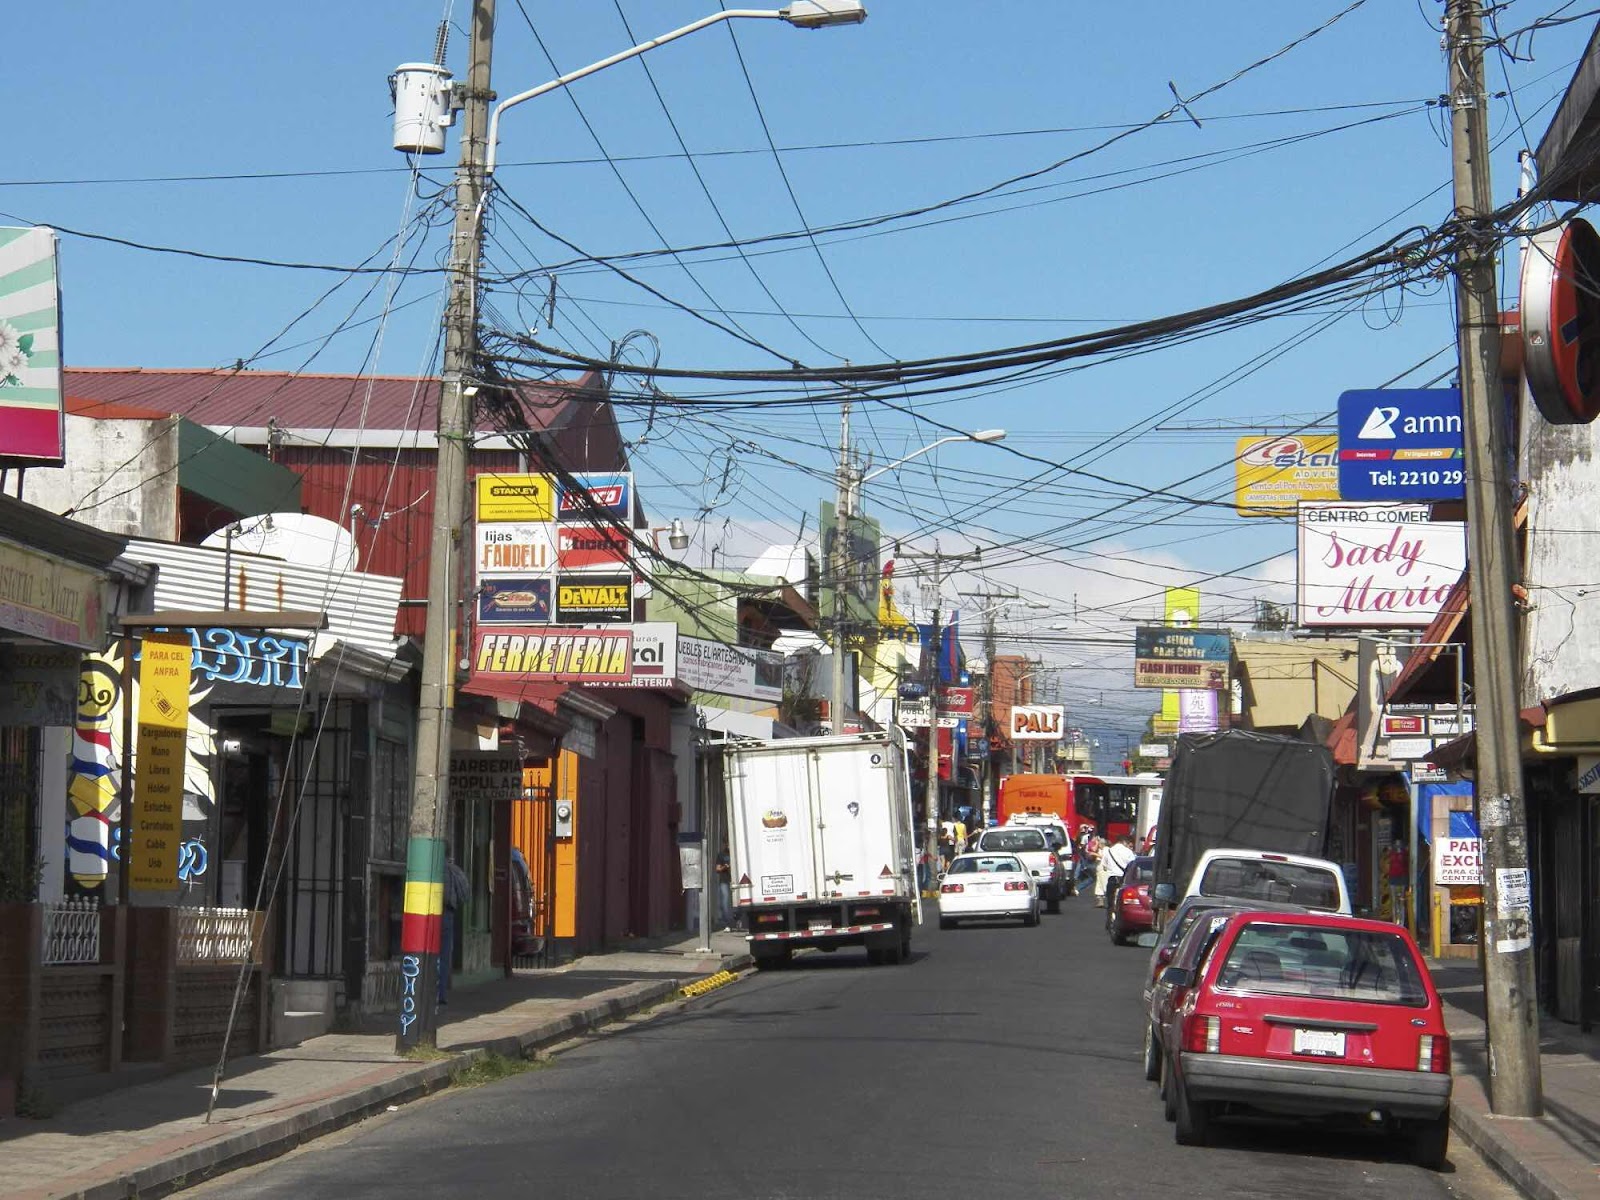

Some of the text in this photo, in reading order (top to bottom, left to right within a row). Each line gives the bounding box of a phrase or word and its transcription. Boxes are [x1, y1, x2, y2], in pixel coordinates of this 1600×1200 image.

[1403, 415, 1461, 433] amn
[1369, 470, 1396, 485] Tel:
[1400, 471, 1439, 485] 2210
[492, 487, 536, 495] STANLEY
[1308, 511, 1428, 522] CENTRO COMER
[485, 531, 512, 544] lijas
[481, 544, 545, 569] FANDELI
[1322, 525, 1425, 577] Sady
[133, 627, 308, 689] LBERT
[150, 650, 169, 660] PARA
[476, 634, 630, 675] FERRETERIA
[632, 642, 664, 662] ral
[1165, 663, 1202, 675] INTERNET
[612, 678, 673, 687] FERRETERIA
[141, 727, 182, 740] Cargadores
[151, 746, 169, 756] Mano
[149, 765, 170, 775] Libres
[449, 759, 520, 773] BARBERIA
[449, 775, 520, 789] POPULAR
[143, 801, 173, 813] Estuche
[146, 839, 166, 849] Cable
[1450, 841, 1480, 852] PAR
[148, 857, 162, 868] Usb
